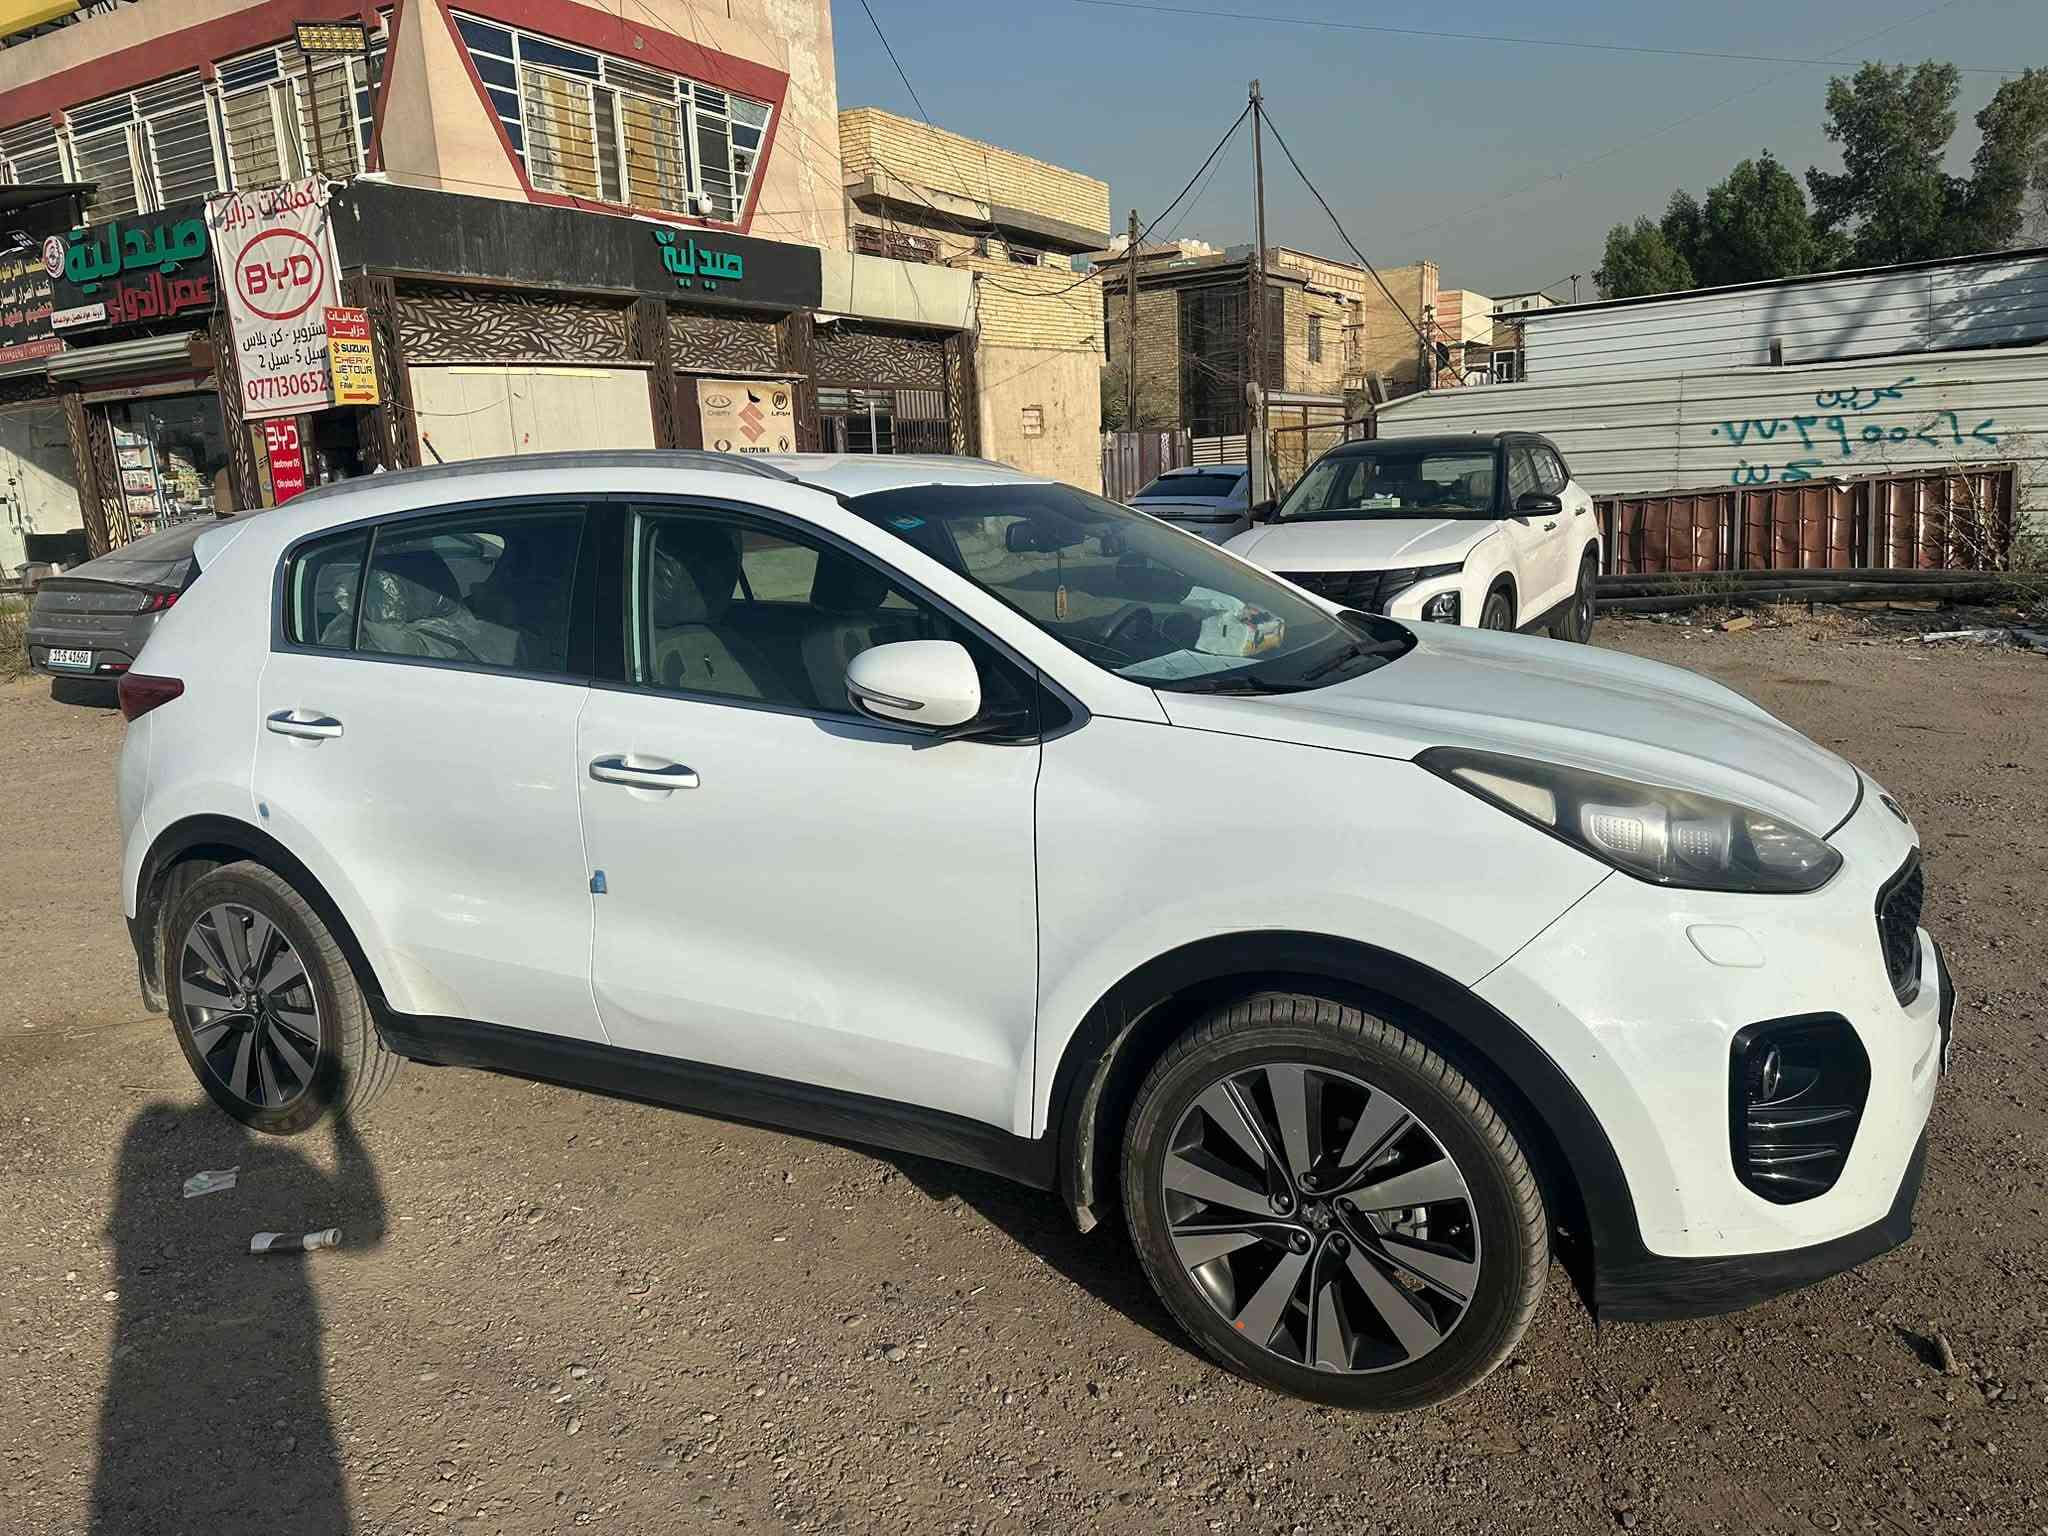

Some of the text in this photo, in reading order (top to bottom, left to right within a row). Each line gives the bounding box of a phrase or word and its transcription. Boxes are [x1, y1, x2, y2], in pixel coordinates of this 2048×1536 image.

[224, 180, 316, 232] كماليات دزاير
[64, 218, 206, 295] صيدلية
[661, 239, 744, 290] صيدلية
[244, 254, 313, 296] BYD
[166, 274, 209, 317] عصر
[327, 310, 366, 323] كماليات
[243, 331, 267, 351] بلاس
[332, 325, 366, 337] دزاير
[295, 348, 302, 363] 5
[341, 343, 370, 353] SUZUKI
[258, 354, 266, 368] 2
[335, 365, 373, 375] JETOUR
[265, 425, 298, 451] BYD
